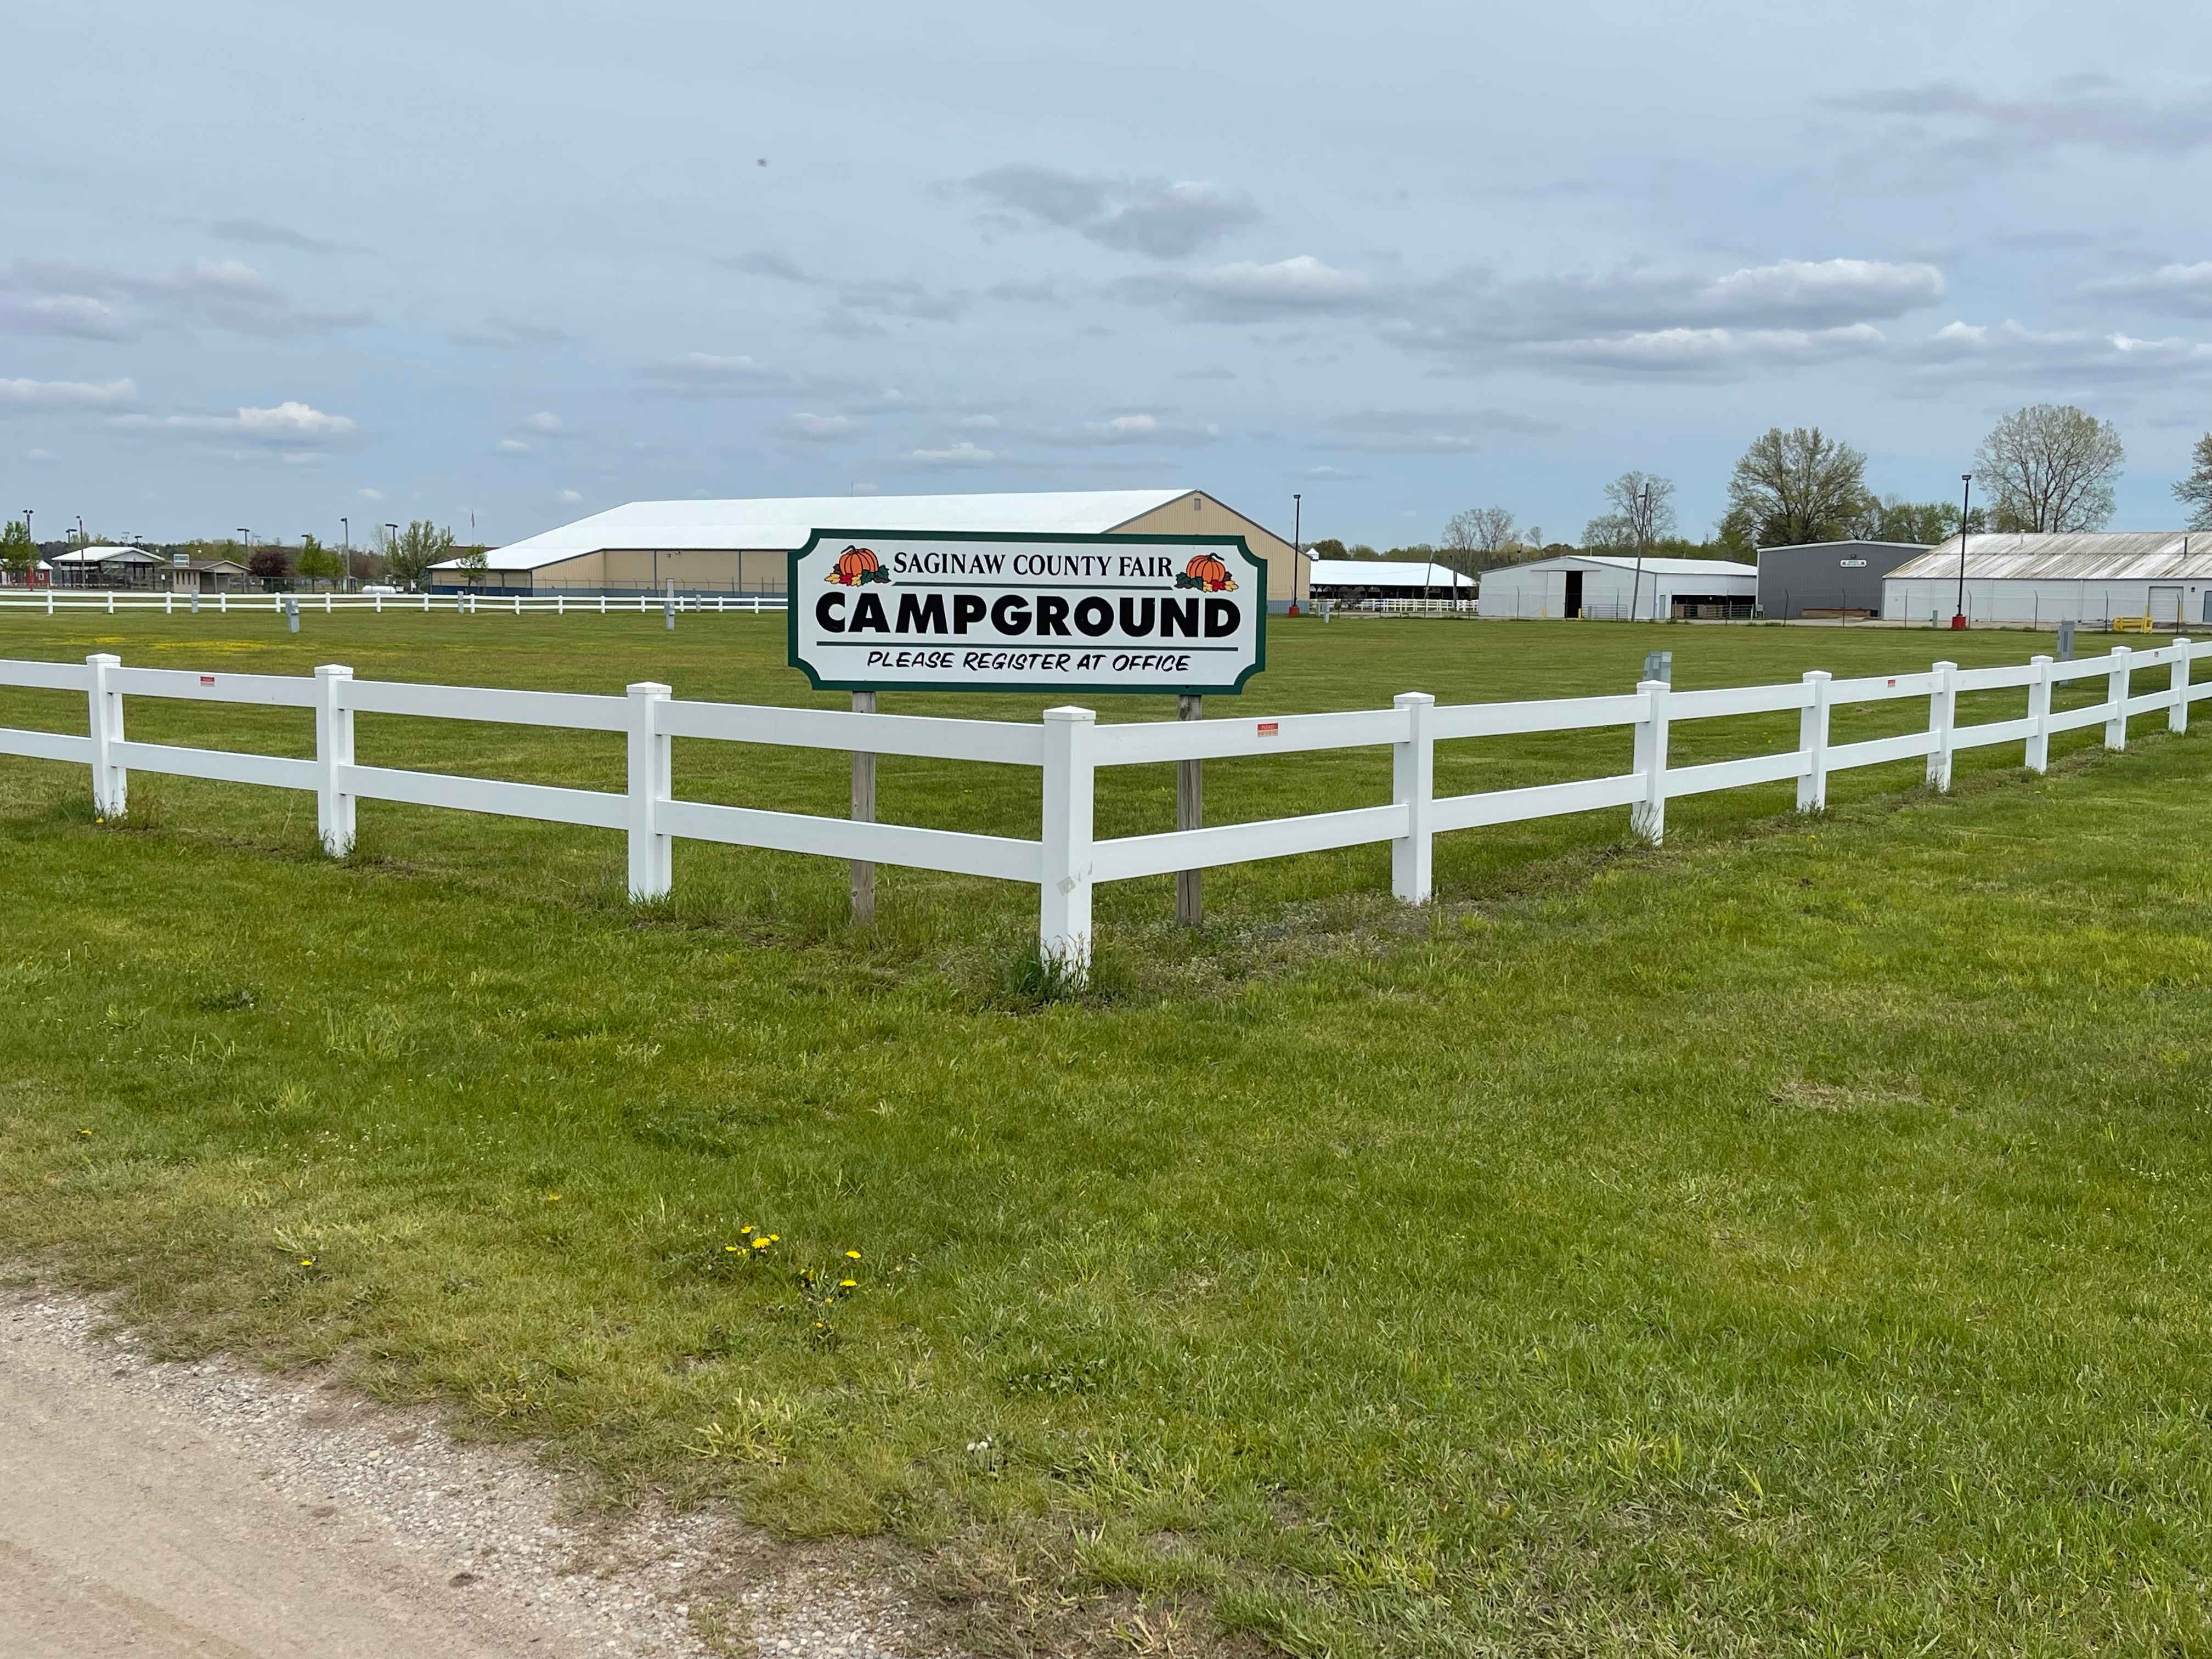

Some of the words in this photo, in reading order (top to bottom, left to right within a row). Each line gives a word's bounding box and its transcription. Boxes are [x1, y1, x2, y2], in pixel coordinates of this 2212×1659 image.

[893, 552, 1006, 574] SAGINAW
[1013, 554, 1112, 576] COUNTY
[1119, 556, 1173, 577] FAIR
[815, 591, 1241, 638] CAMPGROUND
[867, 651, 955, 669] PLEASE
[963, 652, 1070, 672] REGISTER
[1076, 654, 1107, 670] AT
[1112, 654, 1191, 672] OFFICE
